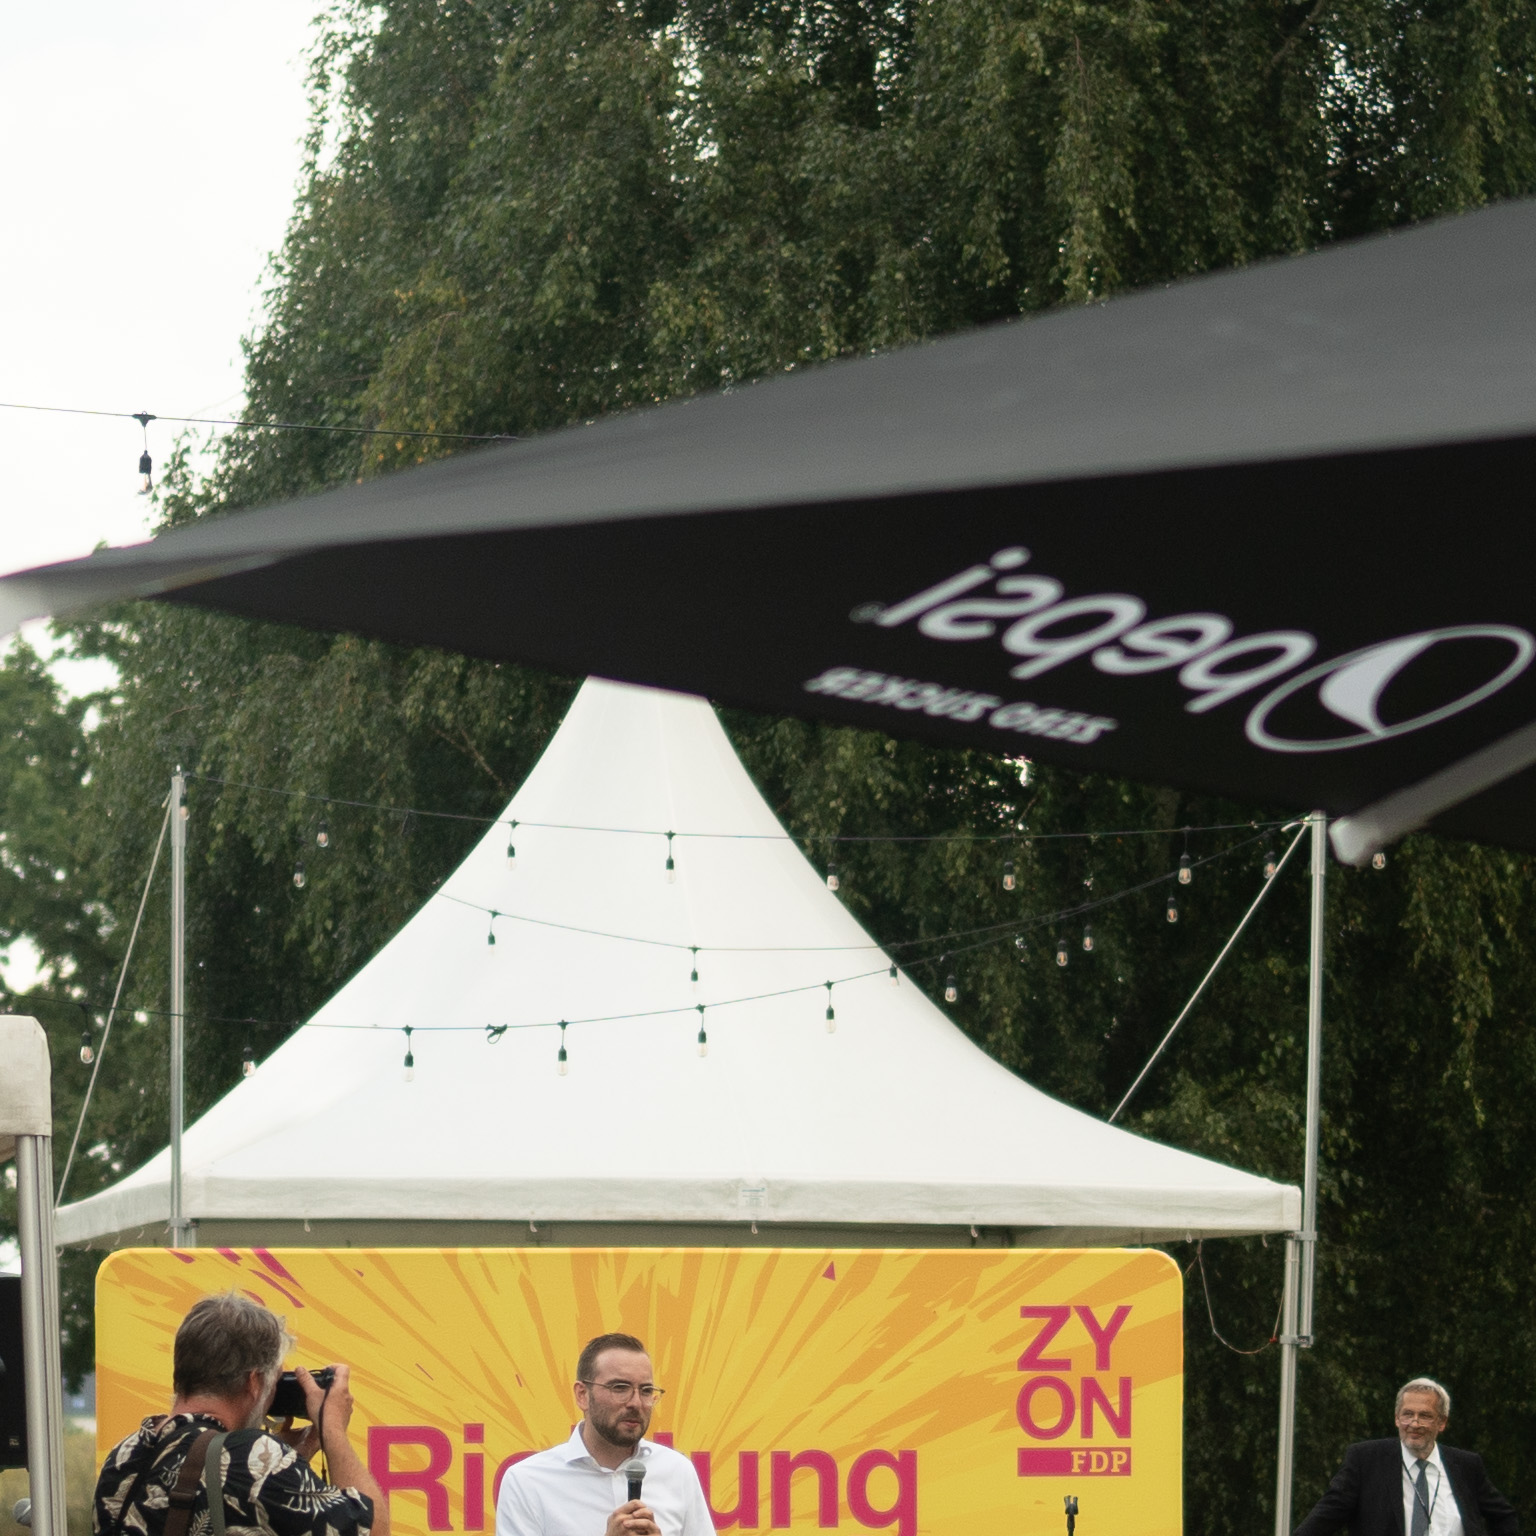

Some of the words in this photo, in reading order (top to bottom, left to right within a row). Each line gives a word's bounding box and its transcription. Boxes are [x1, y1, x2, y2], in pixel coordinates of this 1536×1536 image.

[1017, 1305, 1132, 1372] ZY
[1016, 1376, 1132, 1440] ON
[1071, 1451, 1129, 1475] FDP
